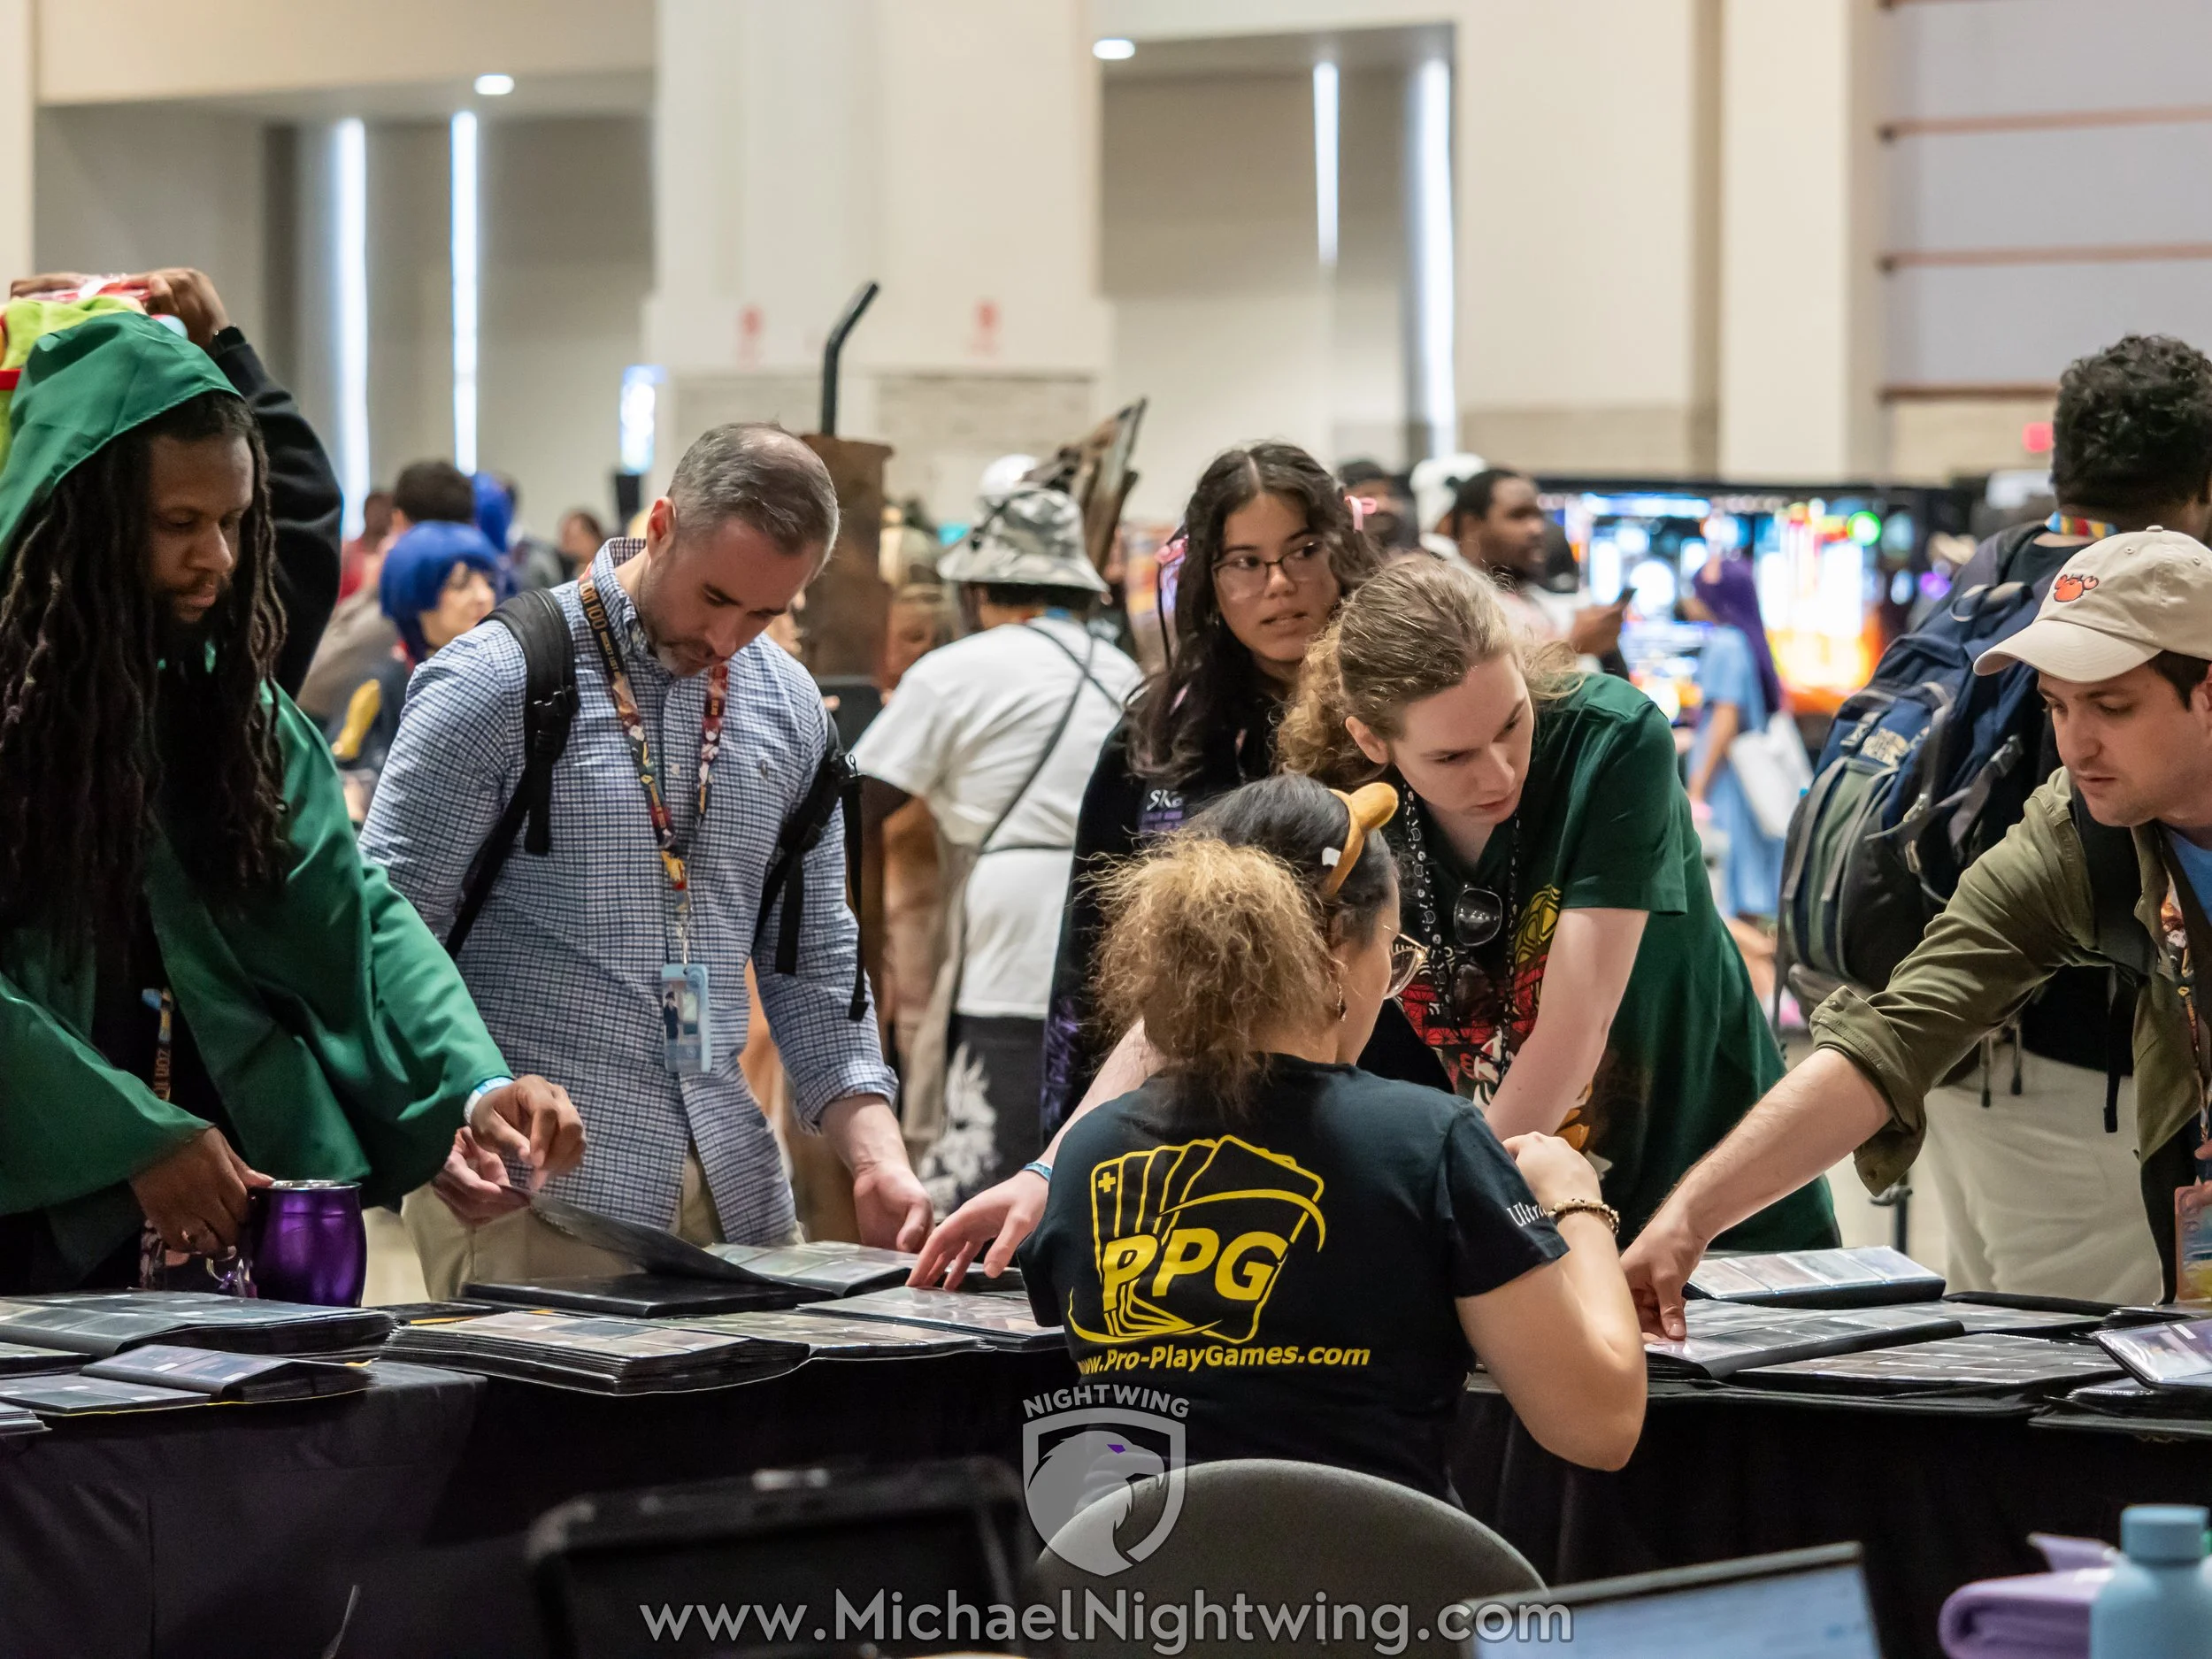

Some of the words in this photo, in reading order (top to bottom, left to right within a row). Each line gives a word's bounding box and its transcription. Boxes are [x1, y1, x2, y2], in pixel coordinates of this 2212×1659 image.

[587, 604, 609, 630] 100
[1102, 1227, 1289, 1312] PPG
[1077, 1345, 1370, 1375] ww.Pro-PlayGames.com
